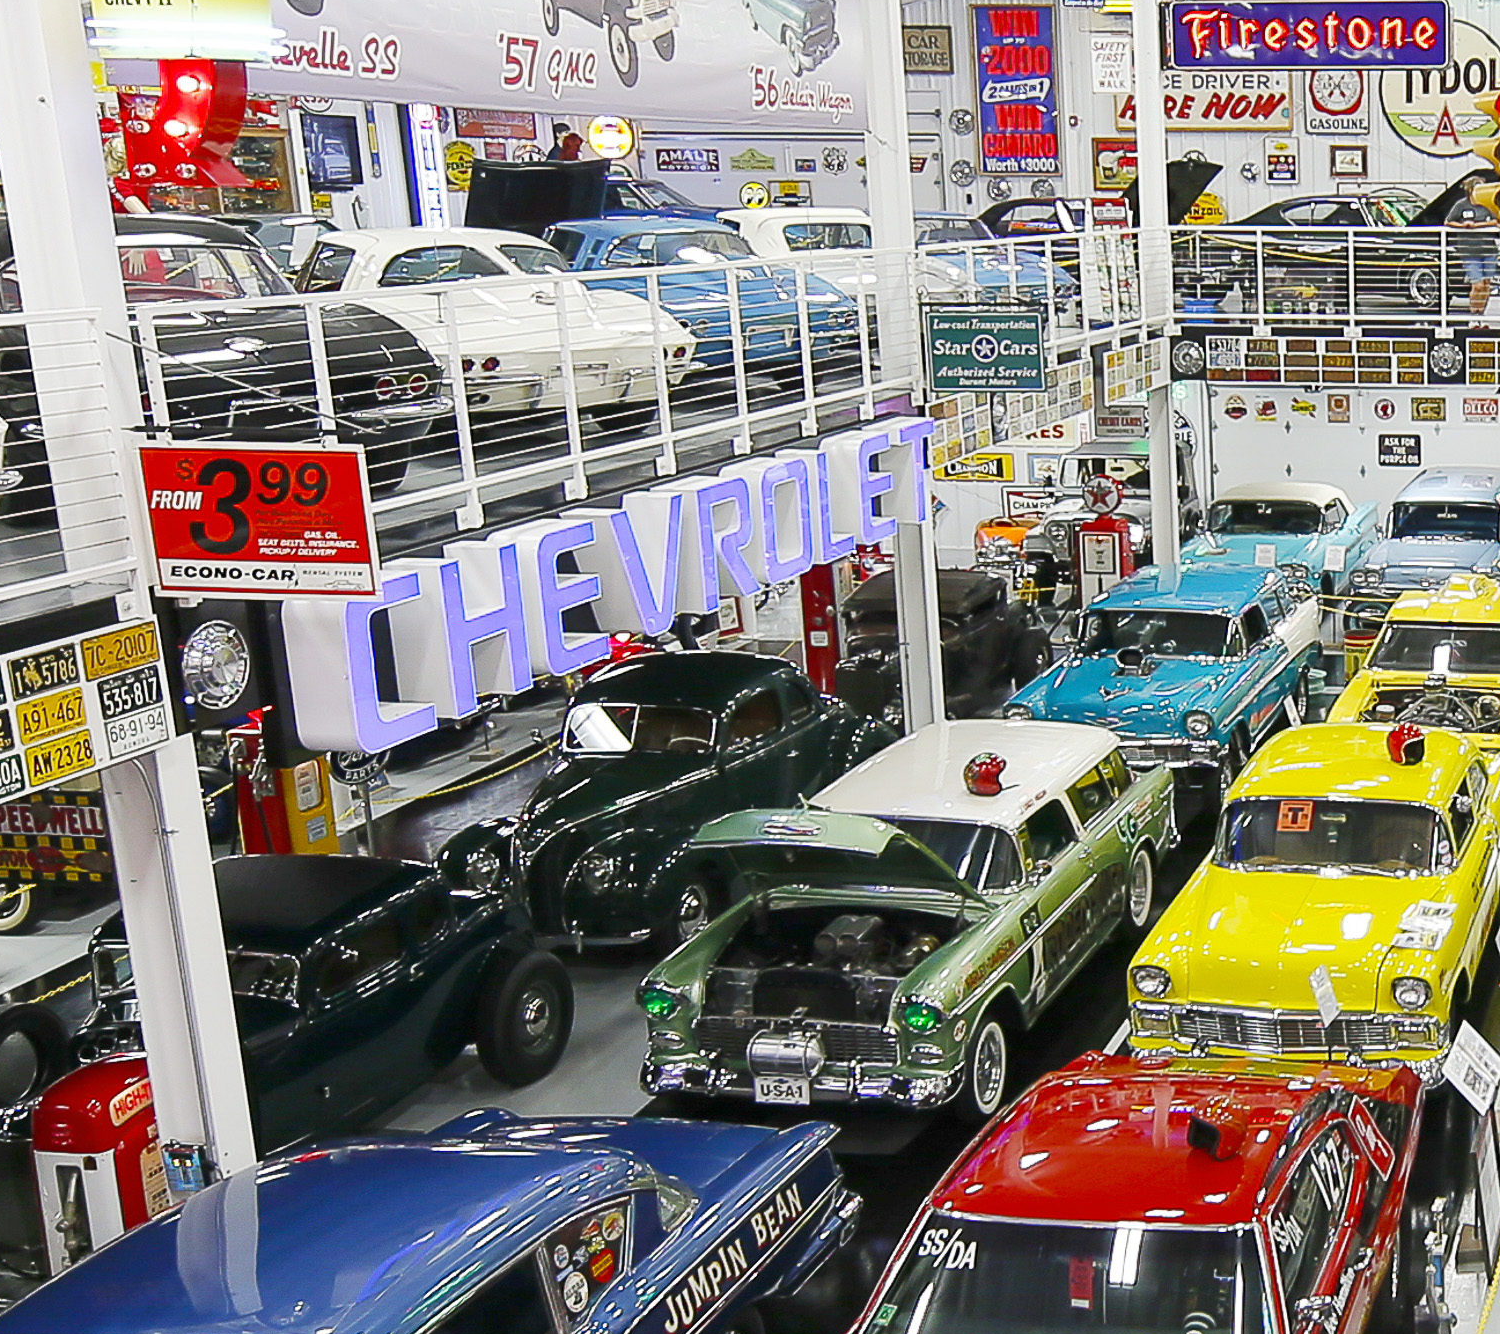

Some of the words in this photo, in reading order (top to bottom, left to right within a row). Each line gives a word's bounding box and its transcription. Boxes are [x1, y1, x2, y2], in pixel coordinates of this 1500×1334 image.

[988, 10, 1038, 37] WIN
[907, 34, 940, 49] CAR
[1181, 9, 1438, 60] Firestone
[1092, 41, 1128, 52] SAFETY
[362, 43, 400, 75] SS
[1095, 53, 1127, 63] FIRST
[549, 49, 597, 97] GMC
[1101, 71, 1121, 79] JAY
[1192, 74, 1271, 89] DRIVER
[1098, 79, 1127, 89] WALK
[1404, 67, 1500, 104] TYDOL
[1201, 92, 1287, 121] NOW
[993, 104, 1045, 131] WIN
[1310, 118, 1367, 131] GASOLINE
[983, 133, 1057, 158] CAMARO
[657, 149, 719, 165] AMALIE
[985, 158, 1018, 172] Worth
[1020, 158, 1055, 172] $3000
[970, 319, 1037, 333] Transportation
[932, 338, 971, 356] Star
[999, 339, 1038, 356] Cars
[937, 366, 994, 379] Authorized
[997, 366, 1038, 379] Service
[988, 378, 1018, 386] Motors
[946, 459, 997, 477] CHAMPION
[150, 490, 203, 510] FROM
[259, 547, 291, 556] PICKUP
[297, 548, 338, 557] DELIVERY
[170, 565, 296, 582] ECONO-CAR
[335, 417, 934, 754] CHEVROLET
[751, 1182, 804, 1251] BEAN
[918, 1229, 978, 1272] SS/DA
